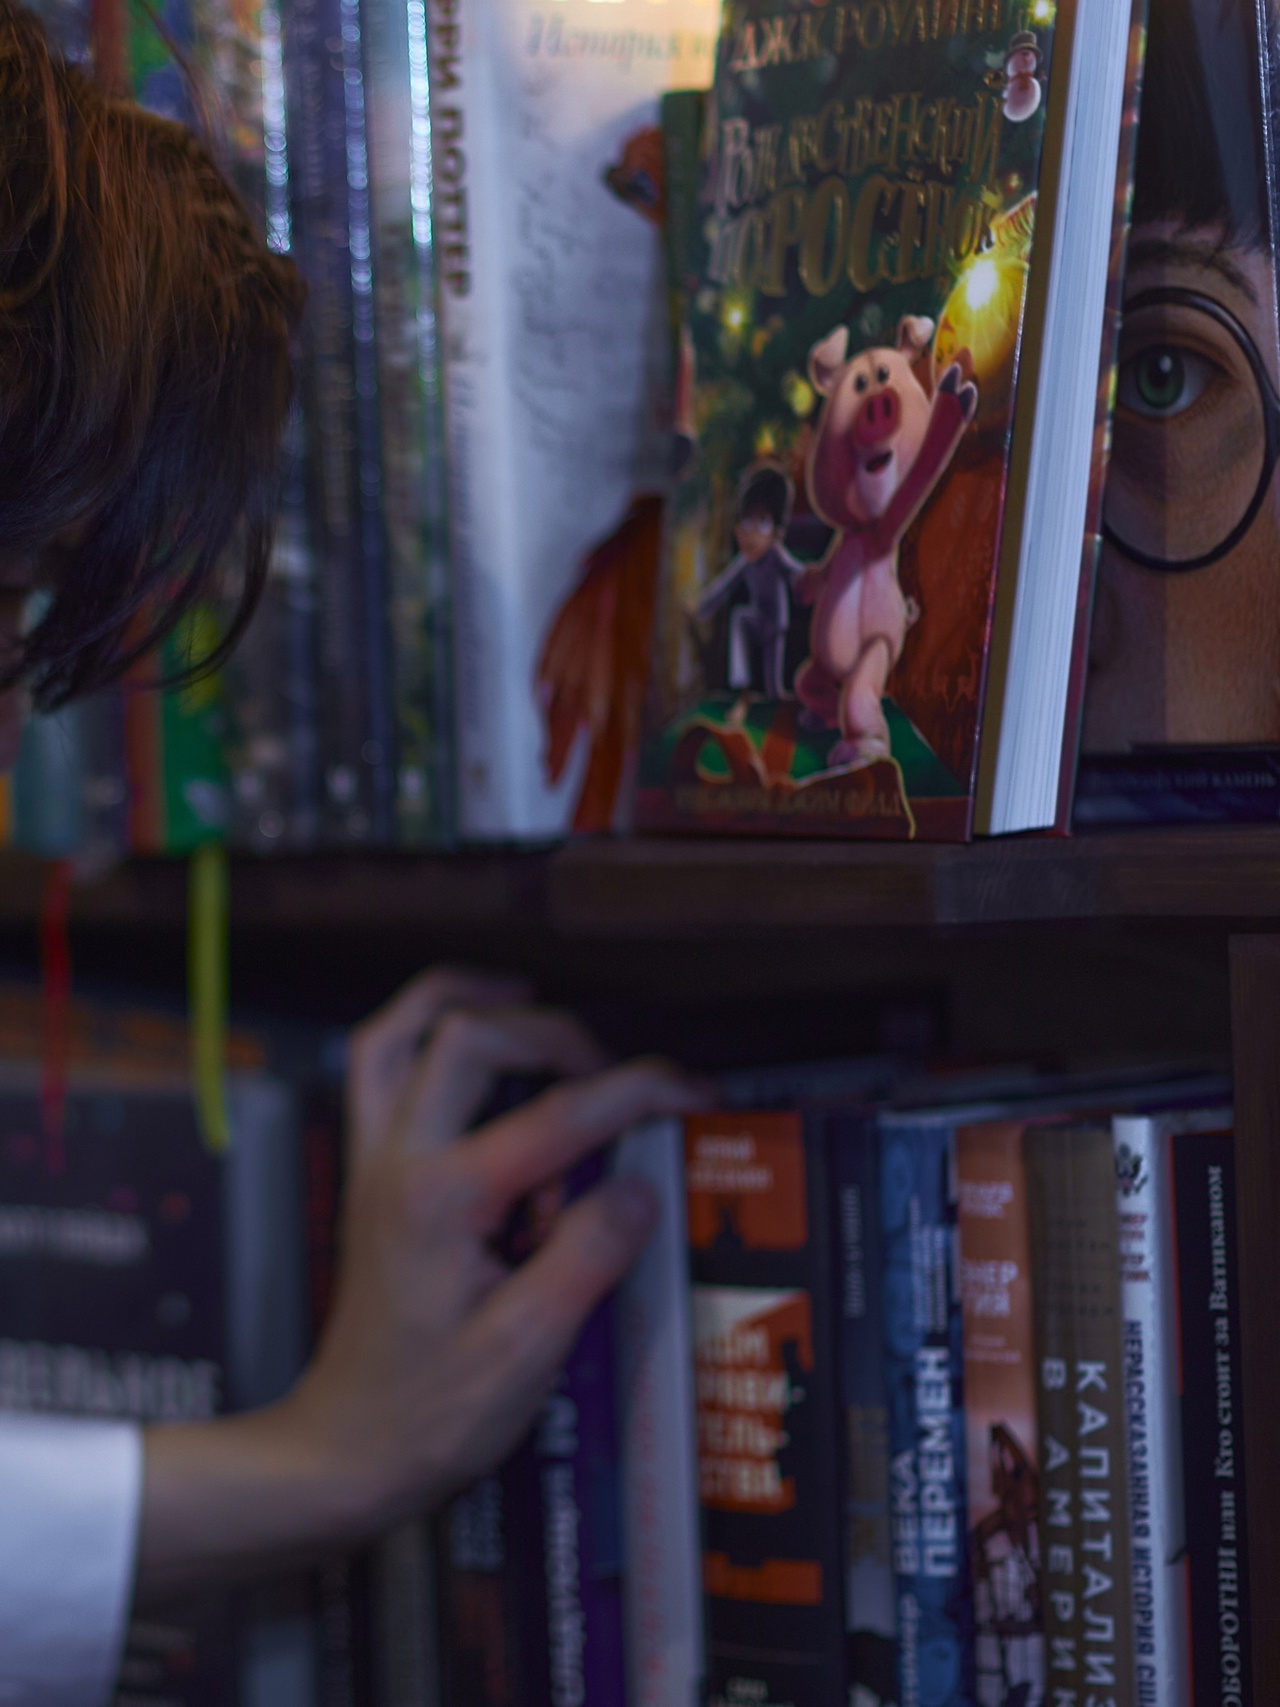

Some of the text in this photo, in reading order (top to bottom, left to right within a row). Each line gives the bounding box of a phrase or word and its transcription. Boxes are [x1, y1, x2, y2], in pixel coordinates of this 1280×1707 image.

[439, 107, 474, 299] ПОТТЕР
[1206, 1164, 1230, 1312] Ватиканом
[1041, 1356, 1068, 1390] В
[1212, 1315, 1231, 1346] за
[1213, 1350, 1233, 1426] стоит
[913, 1345, 960, 1580] ПЕРЕМЕН
[1212, 1428, 1236, 1479] Кто
[891, 1449, 920, 1577] ВЕКА
[1122, 1320, 1160, 1707] НЕРАССКАЗАННАЯ ИСТОРИЯ СШ
[1219, 1489, 1238, 1541] или
